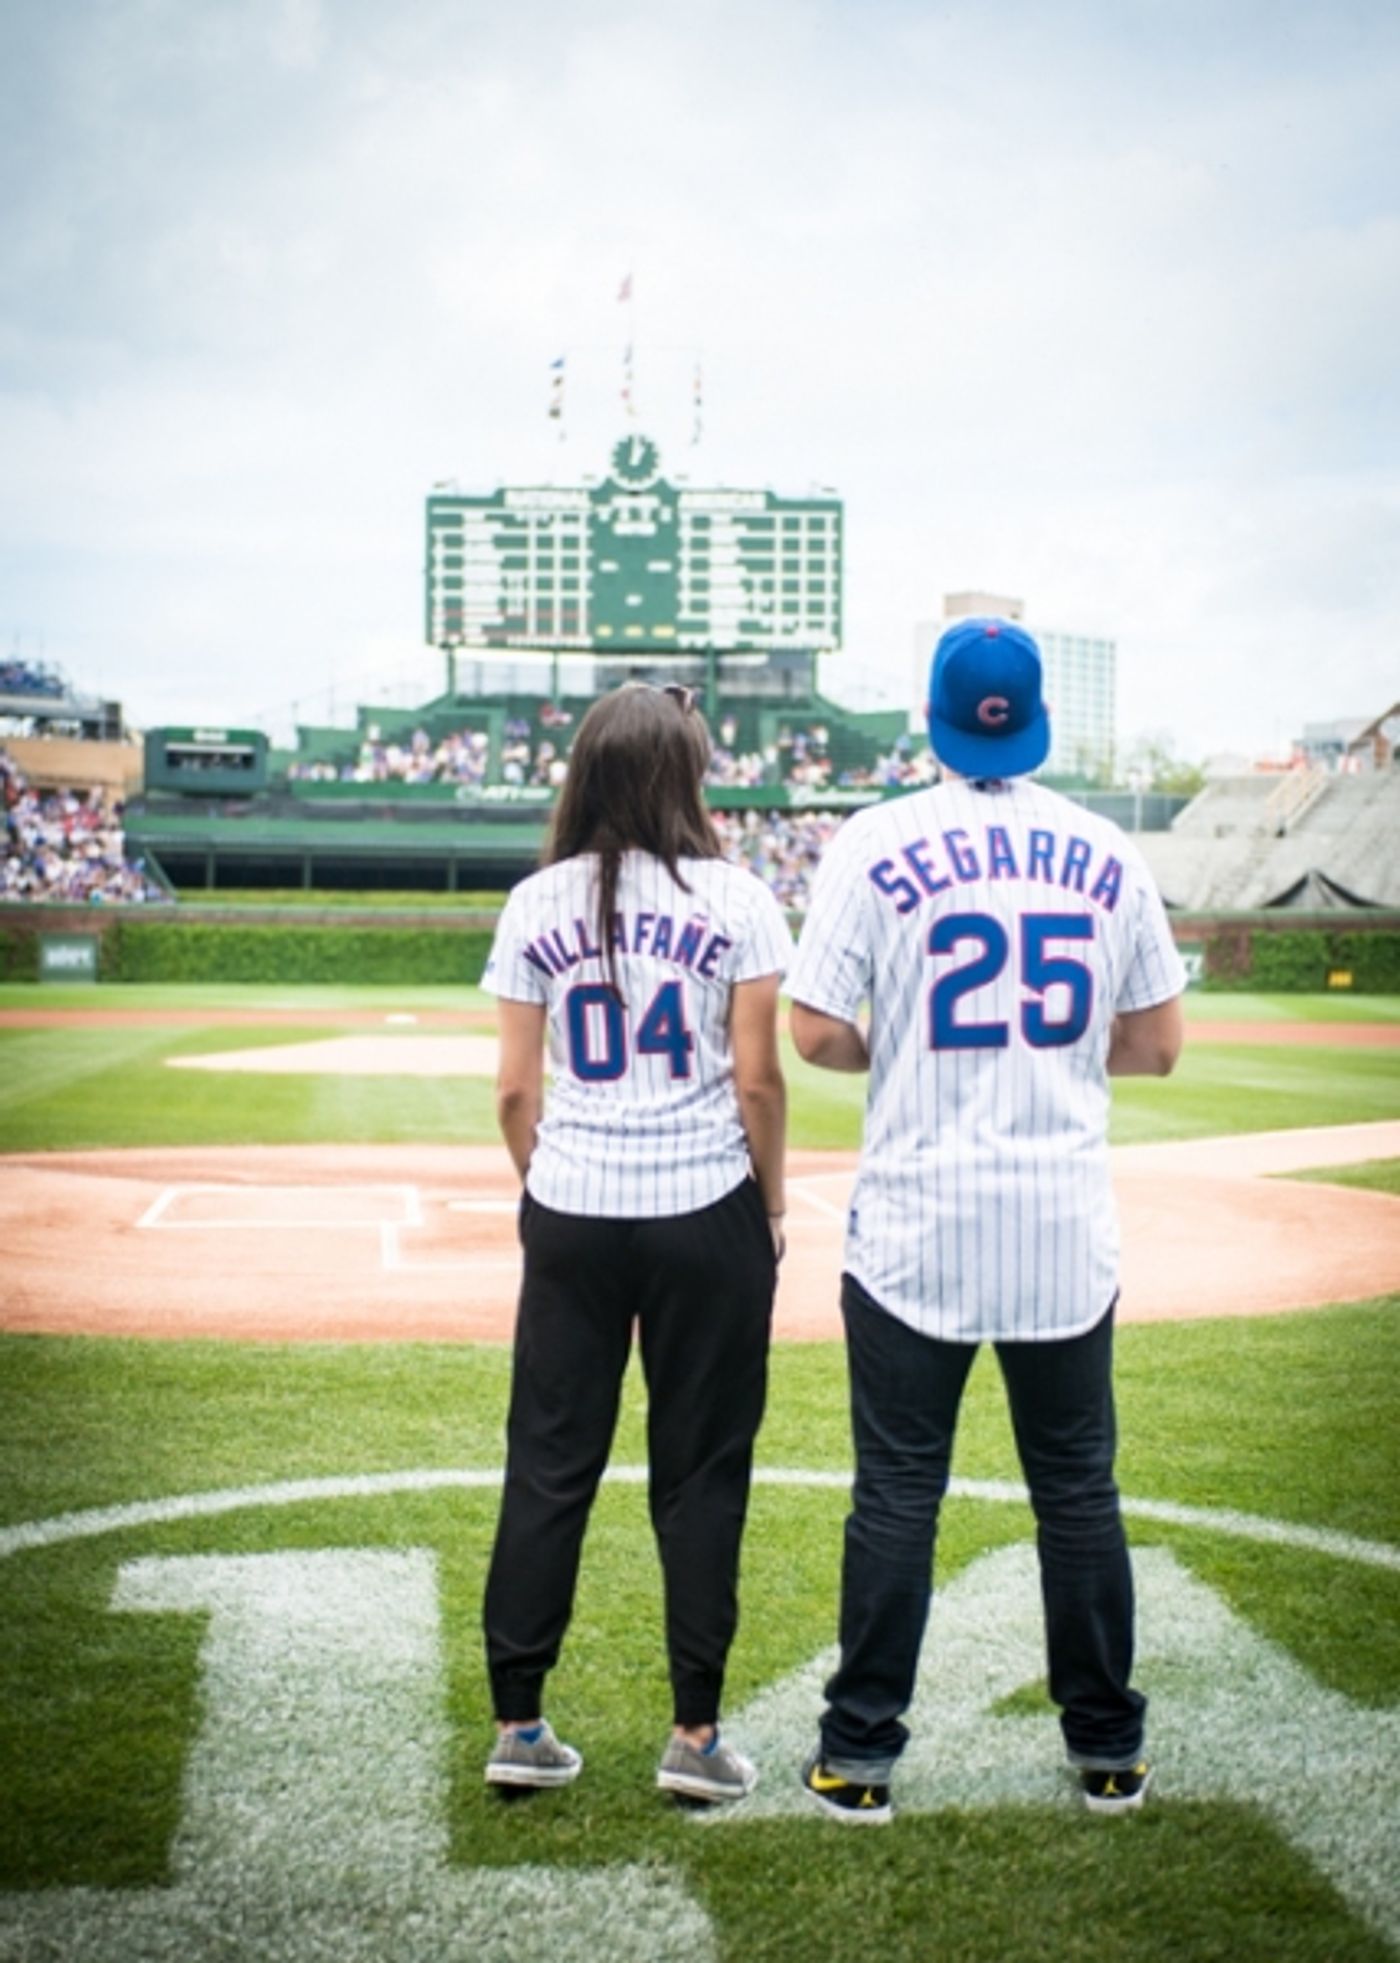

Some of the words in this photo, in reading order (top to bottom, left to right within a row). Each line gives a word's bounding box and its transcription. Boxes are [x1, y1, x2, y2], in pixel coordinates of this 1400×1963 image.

[977, 695, 1009, 727] C
[868, 825, 1124, 914] SEGARRA
[926, 911, 1095, 1051] 25
[566, 980, 694, 1083] 04
